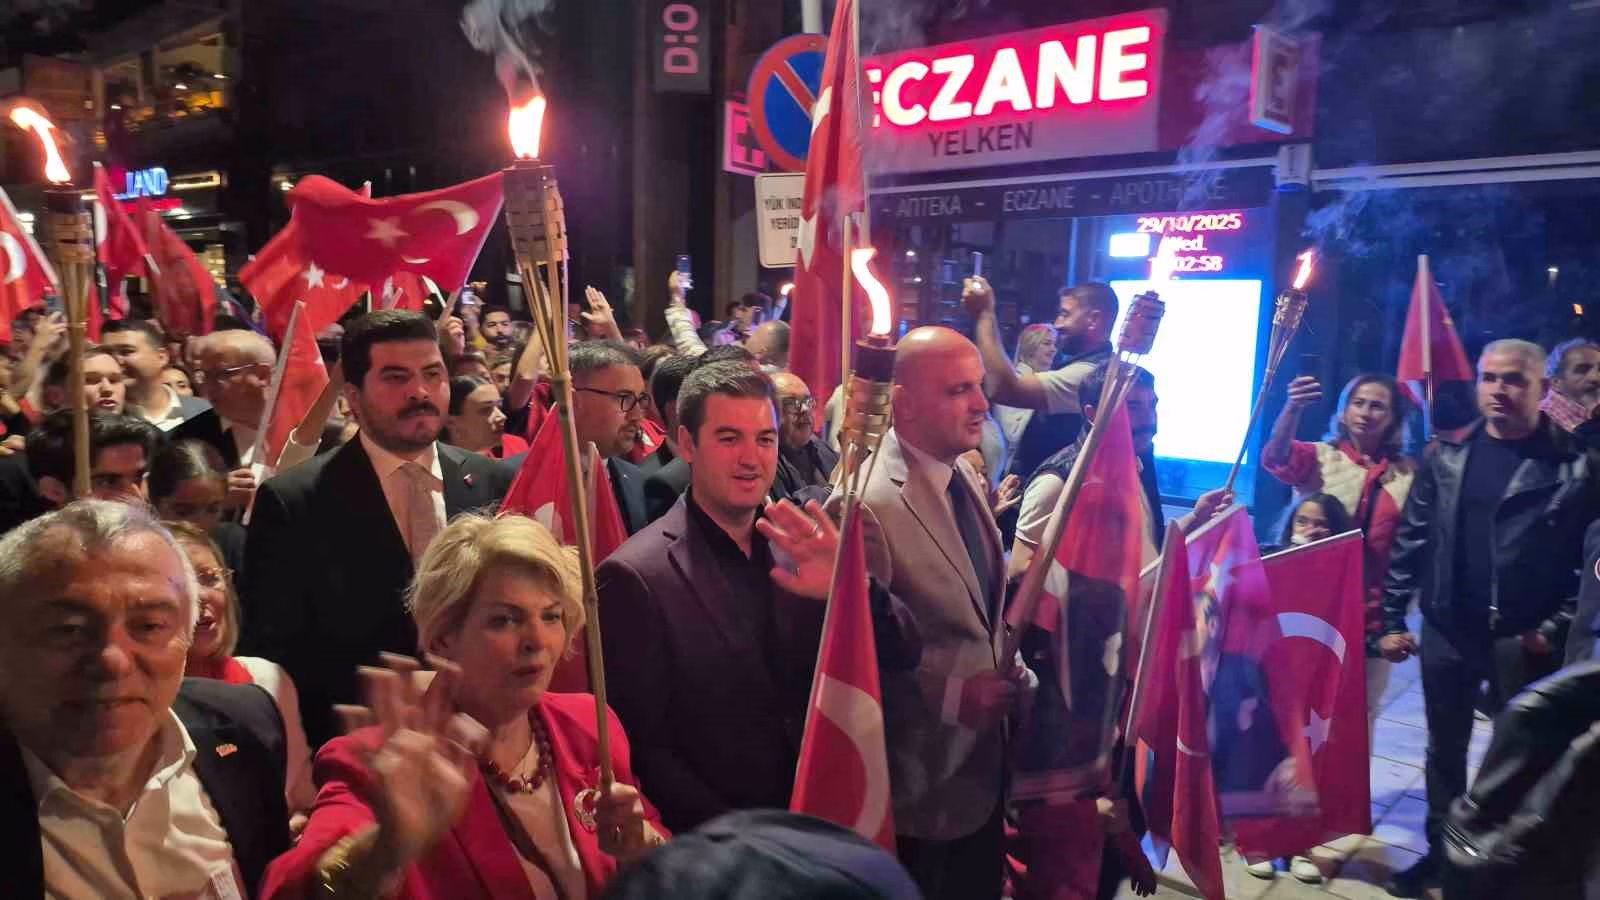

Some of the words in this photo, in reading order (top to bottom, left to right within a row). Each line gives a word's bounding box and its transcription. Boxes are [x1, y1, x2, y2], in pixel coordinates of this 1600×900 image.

[928, 121, 1034, 157] YELKEN
[1003, 186, 1076, 212] ECZANE
[1136, 213, 1241, 233] 29/10/2025
[1148, 254, 1223, 272] 02:58
